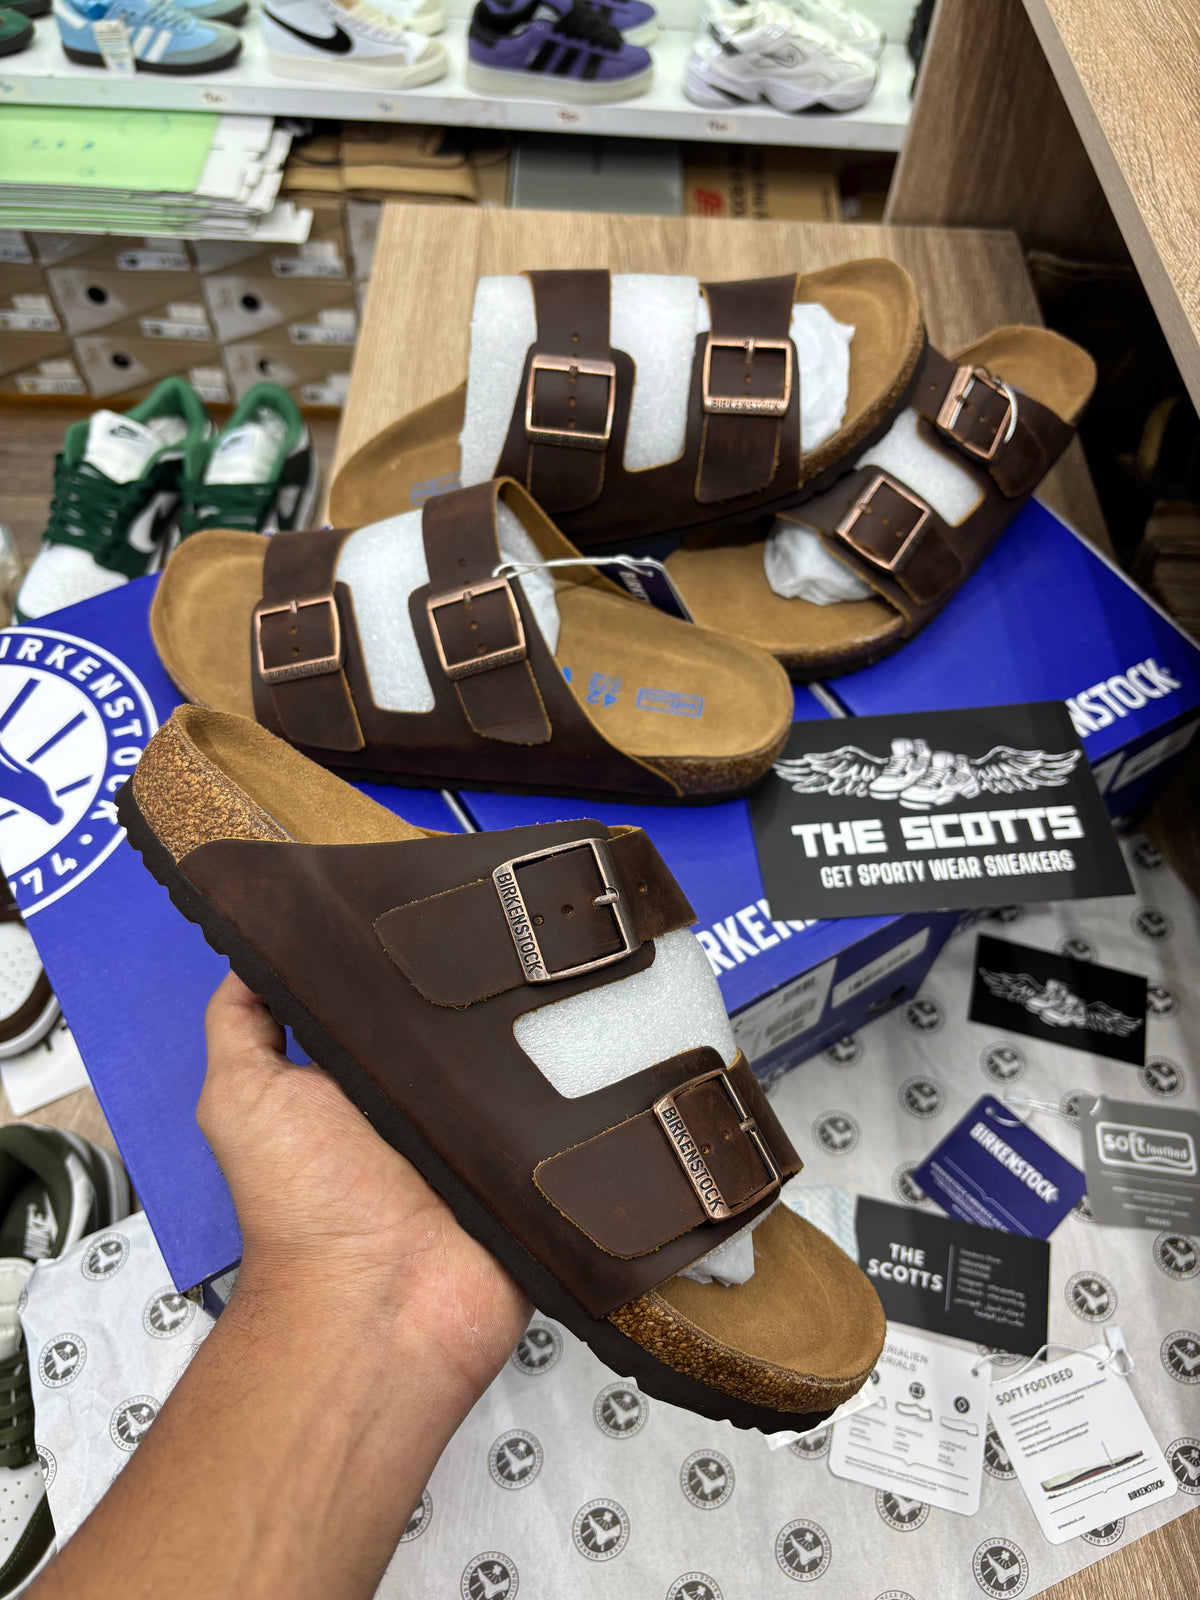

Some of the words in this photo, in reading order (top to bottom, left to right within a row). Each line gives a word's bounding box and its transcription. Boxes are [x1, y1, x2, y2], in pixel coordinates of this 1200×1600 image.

[267, 659, 335, 682] BIRKENSTOCK
[586, 689, 618, 708] 42
[1064, 657, 1182, 739] NSTOCK
[0, 636, 144, 826] IRKENSTOCK
[791, 818, 889, 859] THE
[899, 804, 1085, 852] SCOTTS
[820, 865, 854, 890] GET
[857, 857, 926, 887] SPORTY
[928, 854, 983, 881] WEAR
[984, 848, 1077, 877] SNEAKERS
[496, 871, 544, 976] BIRKENSTOCK
[660, 1105, 726, 1213] BIRKENSTOCK
[968, 1120, 1059, 1205] BIRKENSTOCK
[1102, 1130, 1146, 1154] soft
[866, 1258, 945, 1293] SCOTTS
[889, 1241, 926, 1268] THE
[994, 1386, 1024, 1407] SOFT
[1025, 1367, 1075, 1397] FOOTBED
